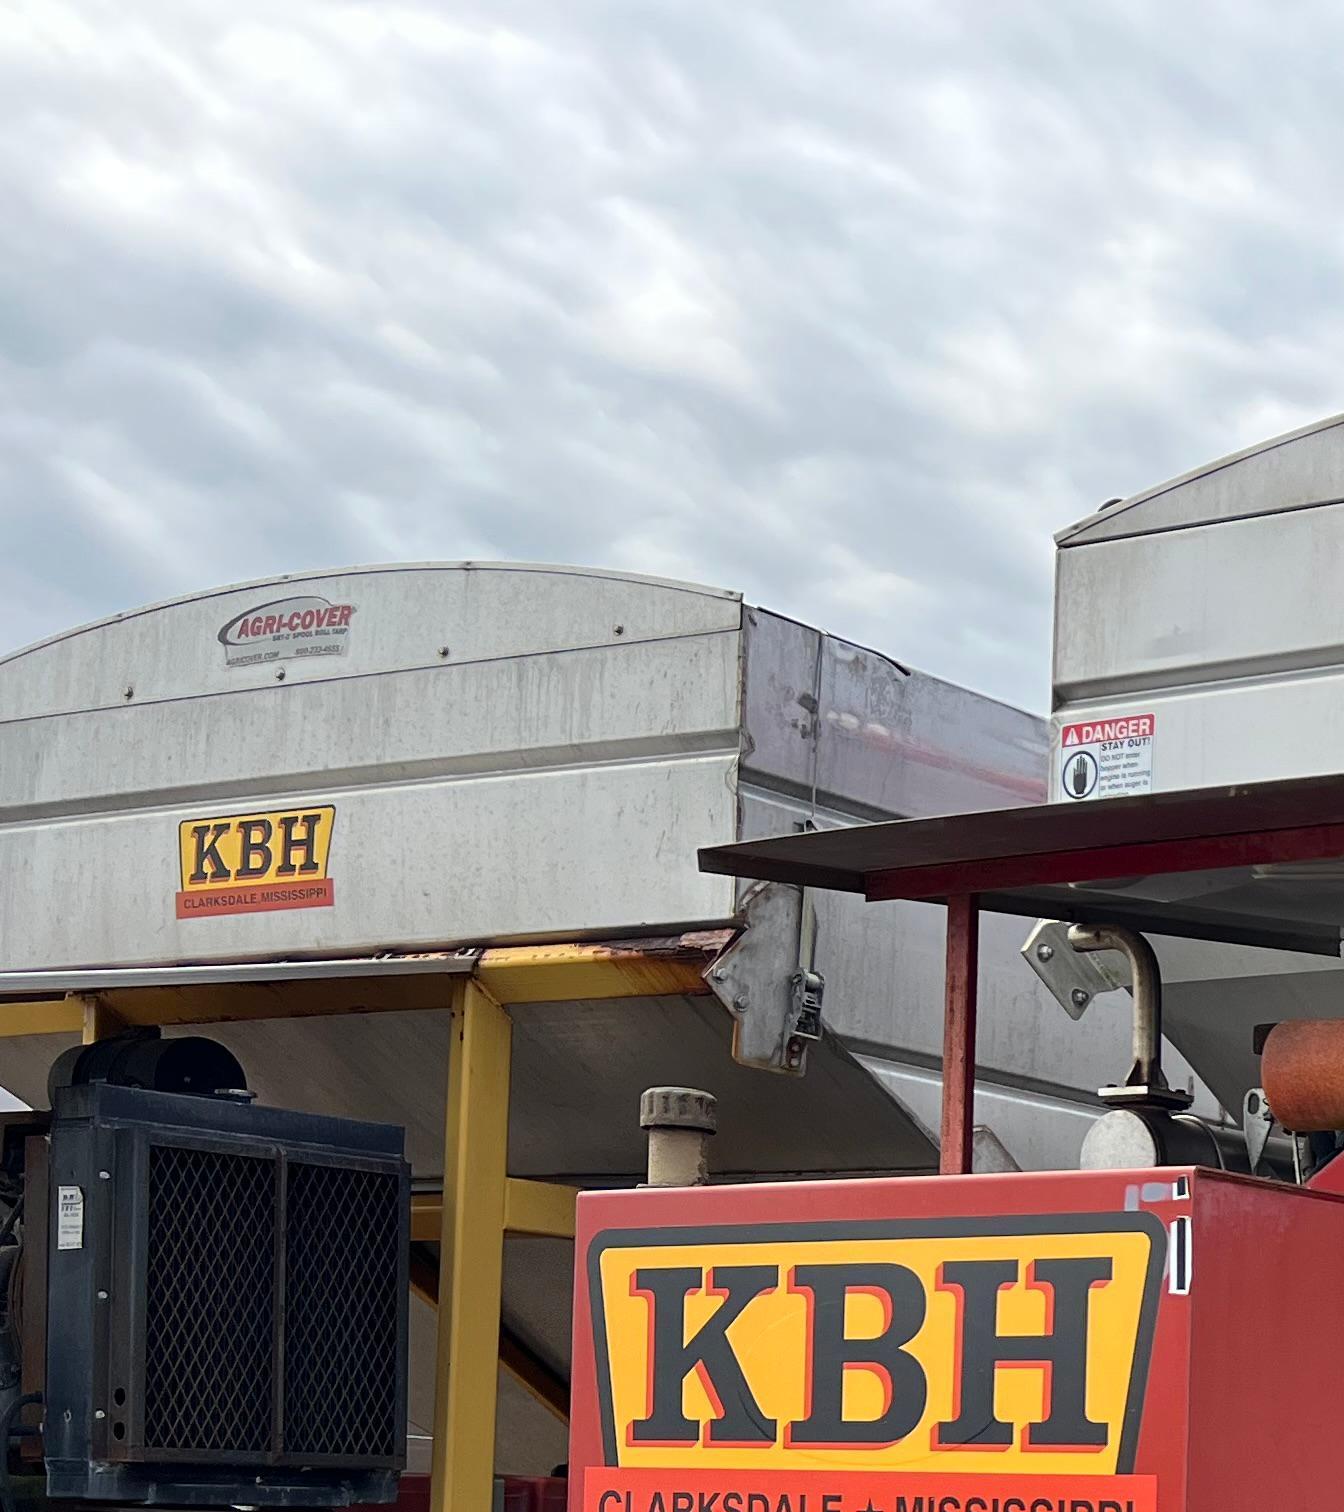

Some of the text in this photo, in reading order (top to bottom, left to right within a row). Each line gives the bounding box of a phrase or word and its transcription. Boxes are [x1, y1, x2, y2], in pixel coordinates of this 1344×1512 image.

[237, 605, 352, 639] AGRI-COVER
[1082, 718, 1151, 743] DANGER
[1101, 736, 1151, 751] STAY OUT!
[189, 813, 322, 884] KBH
[625, 1256, 1113, 1453] KBH
